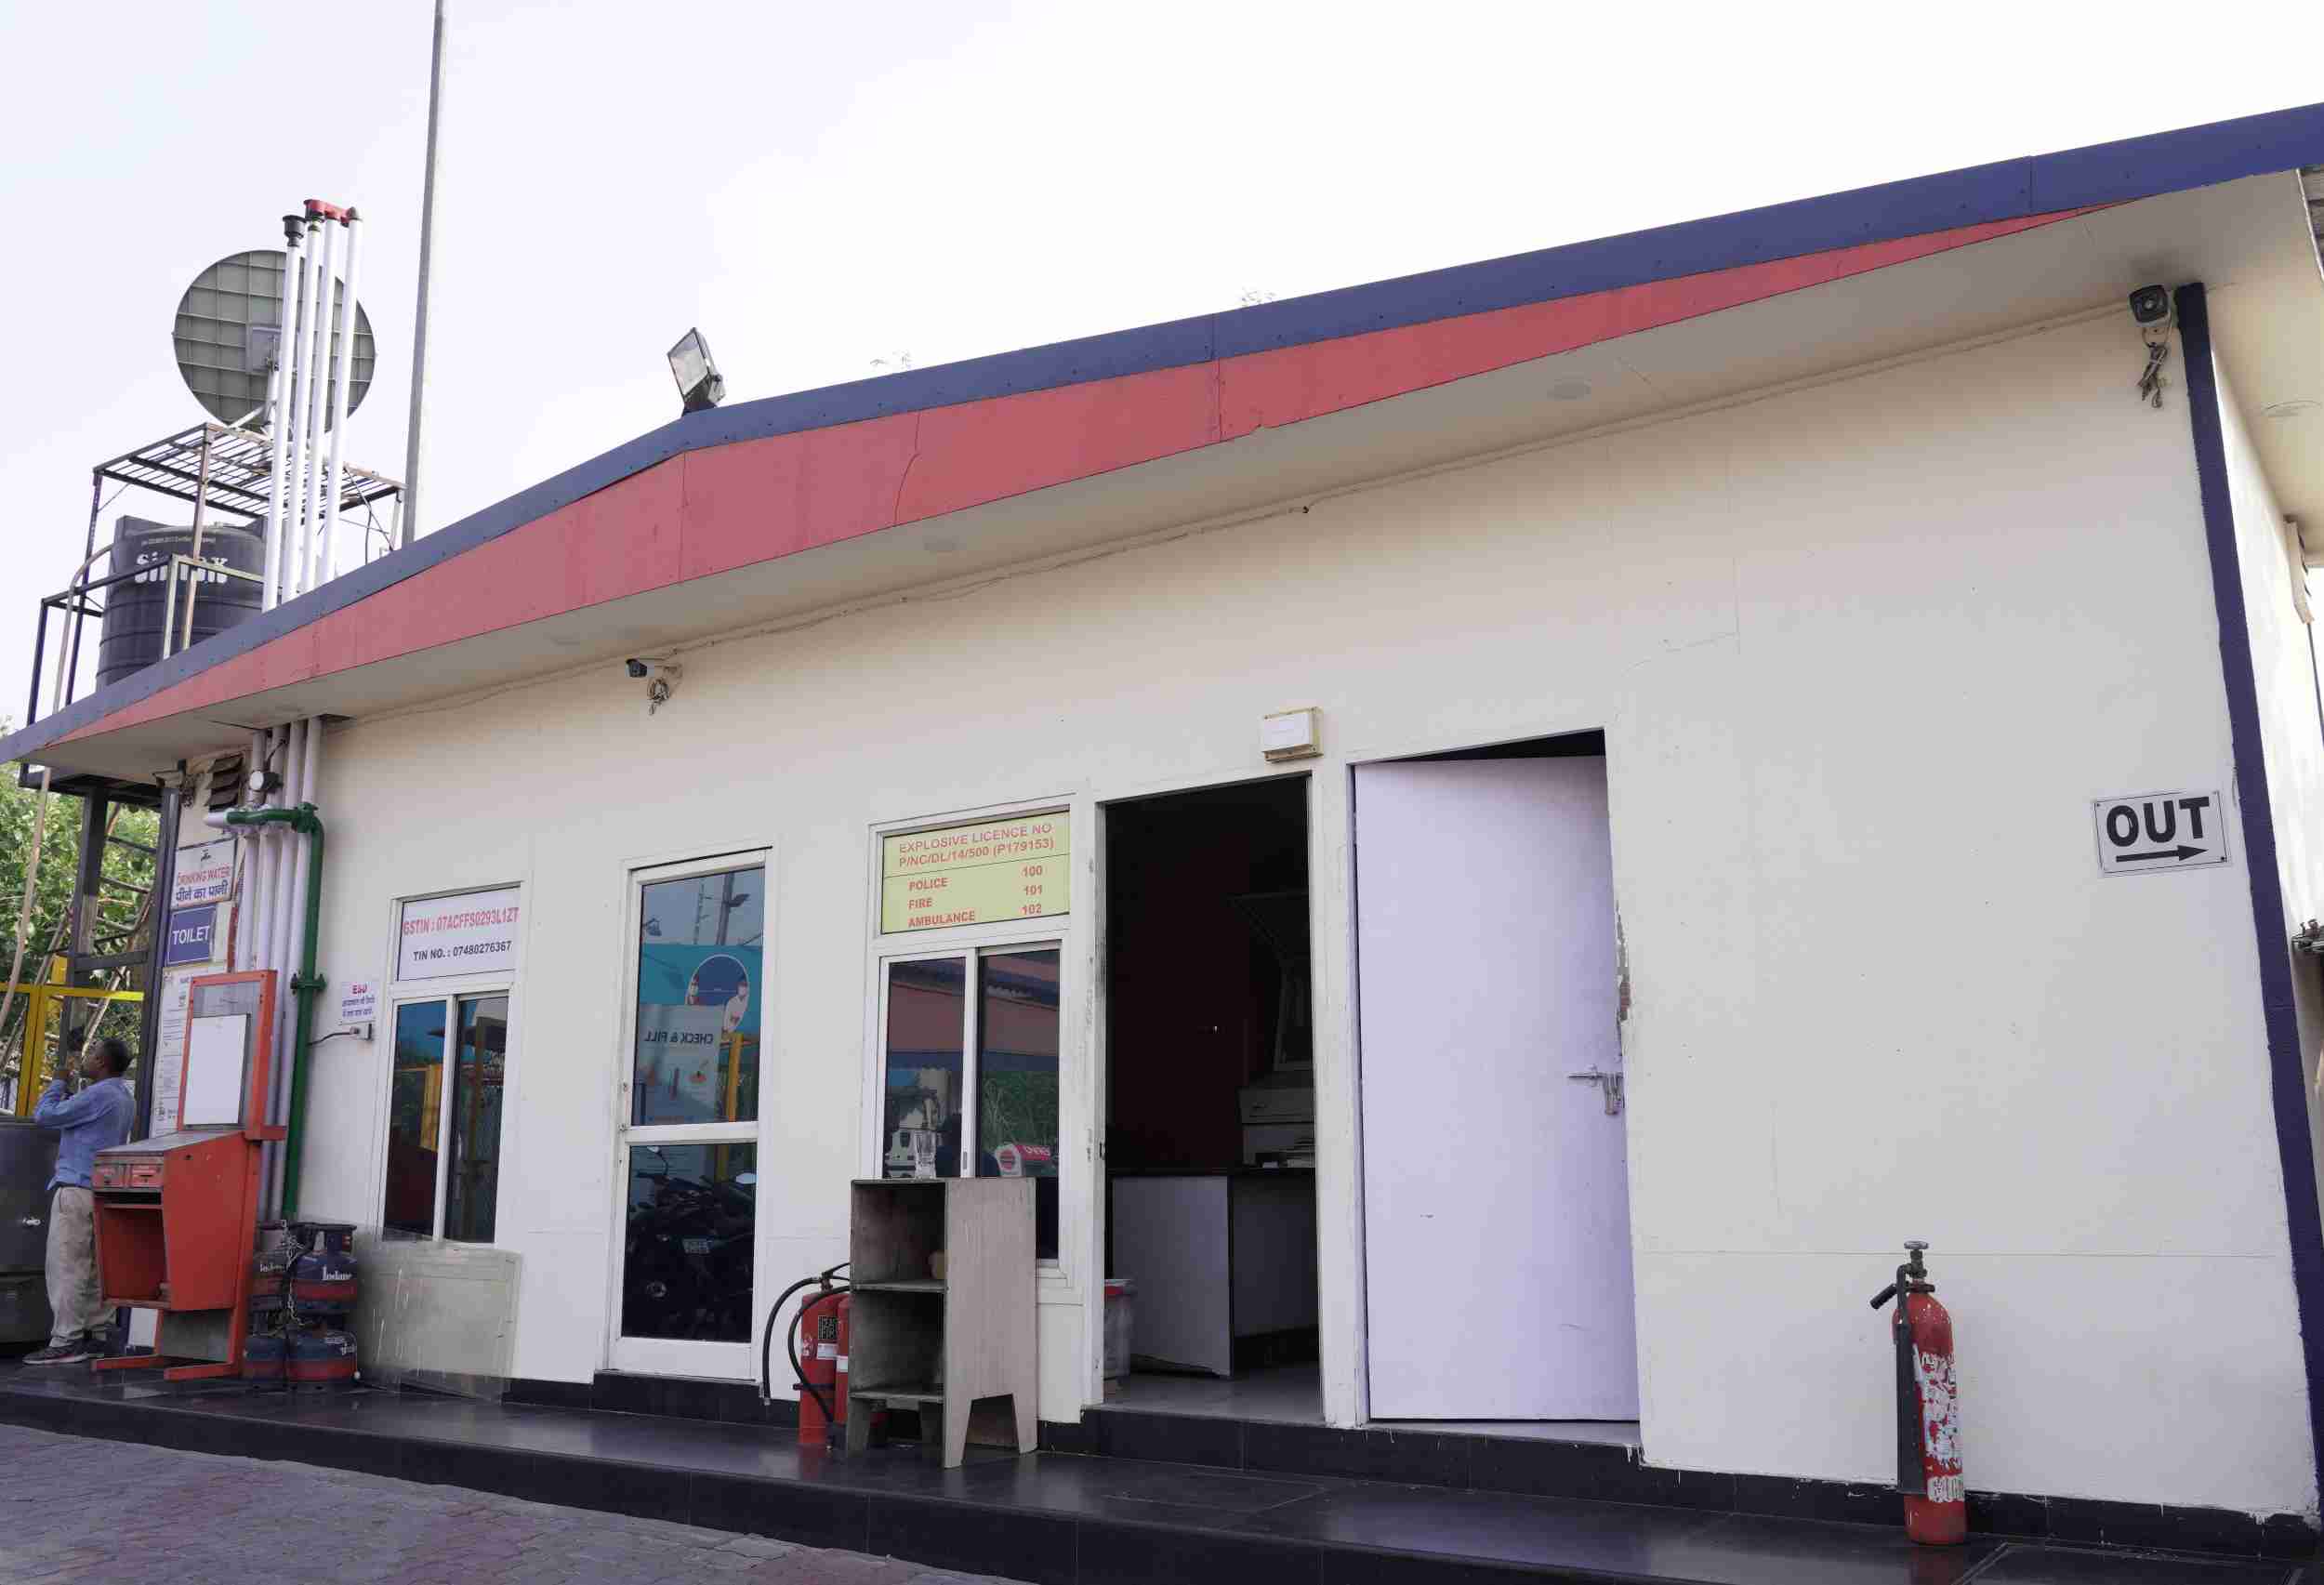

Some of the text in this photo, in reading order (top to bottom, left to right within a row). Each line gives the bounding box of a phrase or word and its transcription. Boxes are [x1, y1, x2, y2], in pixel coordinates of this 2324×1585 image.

[2106, 796, 2210, 847] OUT
[899, 823, 1052, 853] EXPLOSIVE LICENCE NO
[899, 838, 1054, 867] P/NC/DL/14/500 (P179153)
[908, 865, 1042, 892] POLICE 100
[908, 885, 1042, 909] FIRE 101
[908, 904, 1042, 928] AMBULANCE 102
[172, 925, 210, 945] TOILET
[414, 951, 428, 961] TIN
